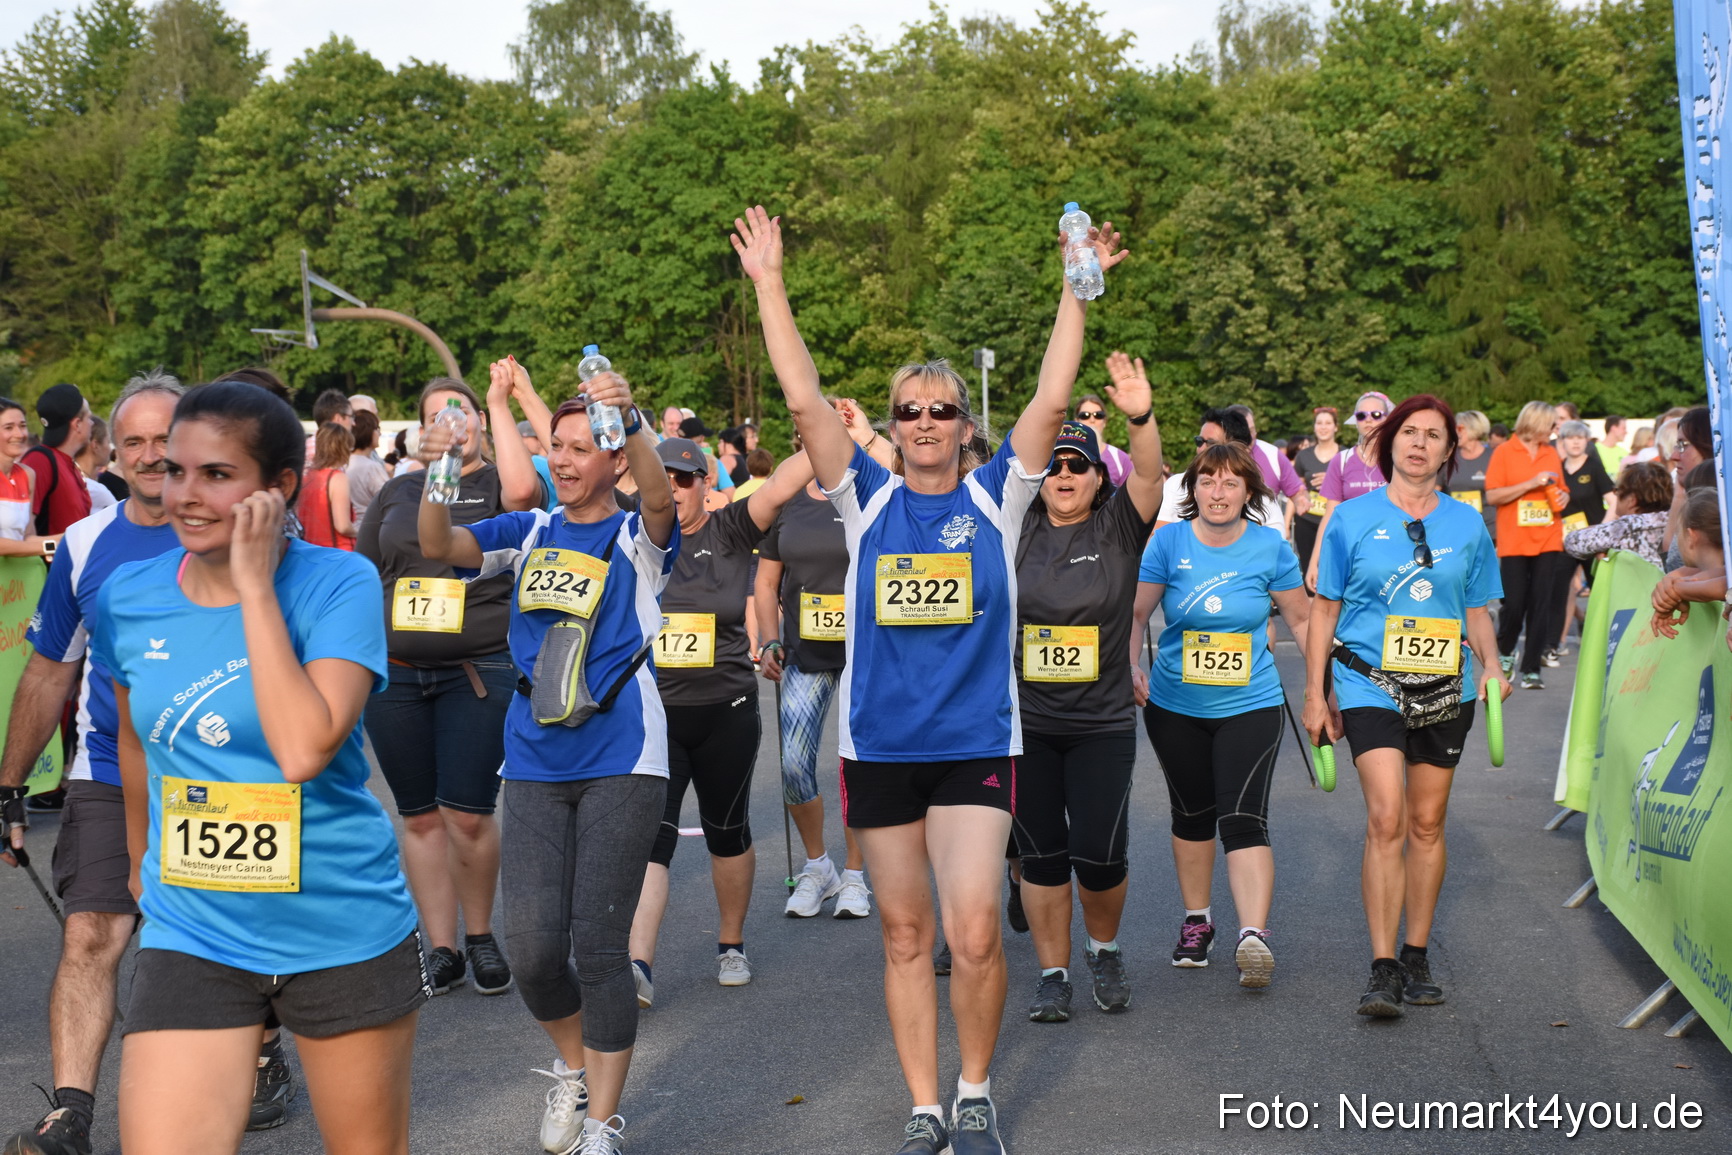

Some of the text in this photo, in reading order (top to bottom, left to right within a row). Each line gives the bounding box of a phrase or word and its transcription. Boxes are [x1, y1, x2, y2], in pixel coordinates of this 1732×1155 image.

[889, 567, 927, 575] firmenlauf
[1379, 547, 1453, 597] Team Sch Bau
[526, 570, 591, 598] 2324
[887, 579, 959, 605] 2322
[1177, 571, 1238, 610] Team Schick Bau
[408, 597, 446, 617] 173
[551, 592, 573, 602] Agnes
[812, 611, 846, 628] 152
[658, 633, 698, 652] 172
[1394, 636, 1450, 658] 1527
[1039, 646, 1081, 667] 182
[1191, 650, 1243, 671] 1525
[172, 669, 225, 706] Schick
[226, 657, 249, 673] Ba
[178, 799, 229, 814] firmenlauf
[262, 812, 291, 822] 2019
[177, 819, 278, 861] 1528
[180, 858, 273, 874] Nestmeyer Carina
